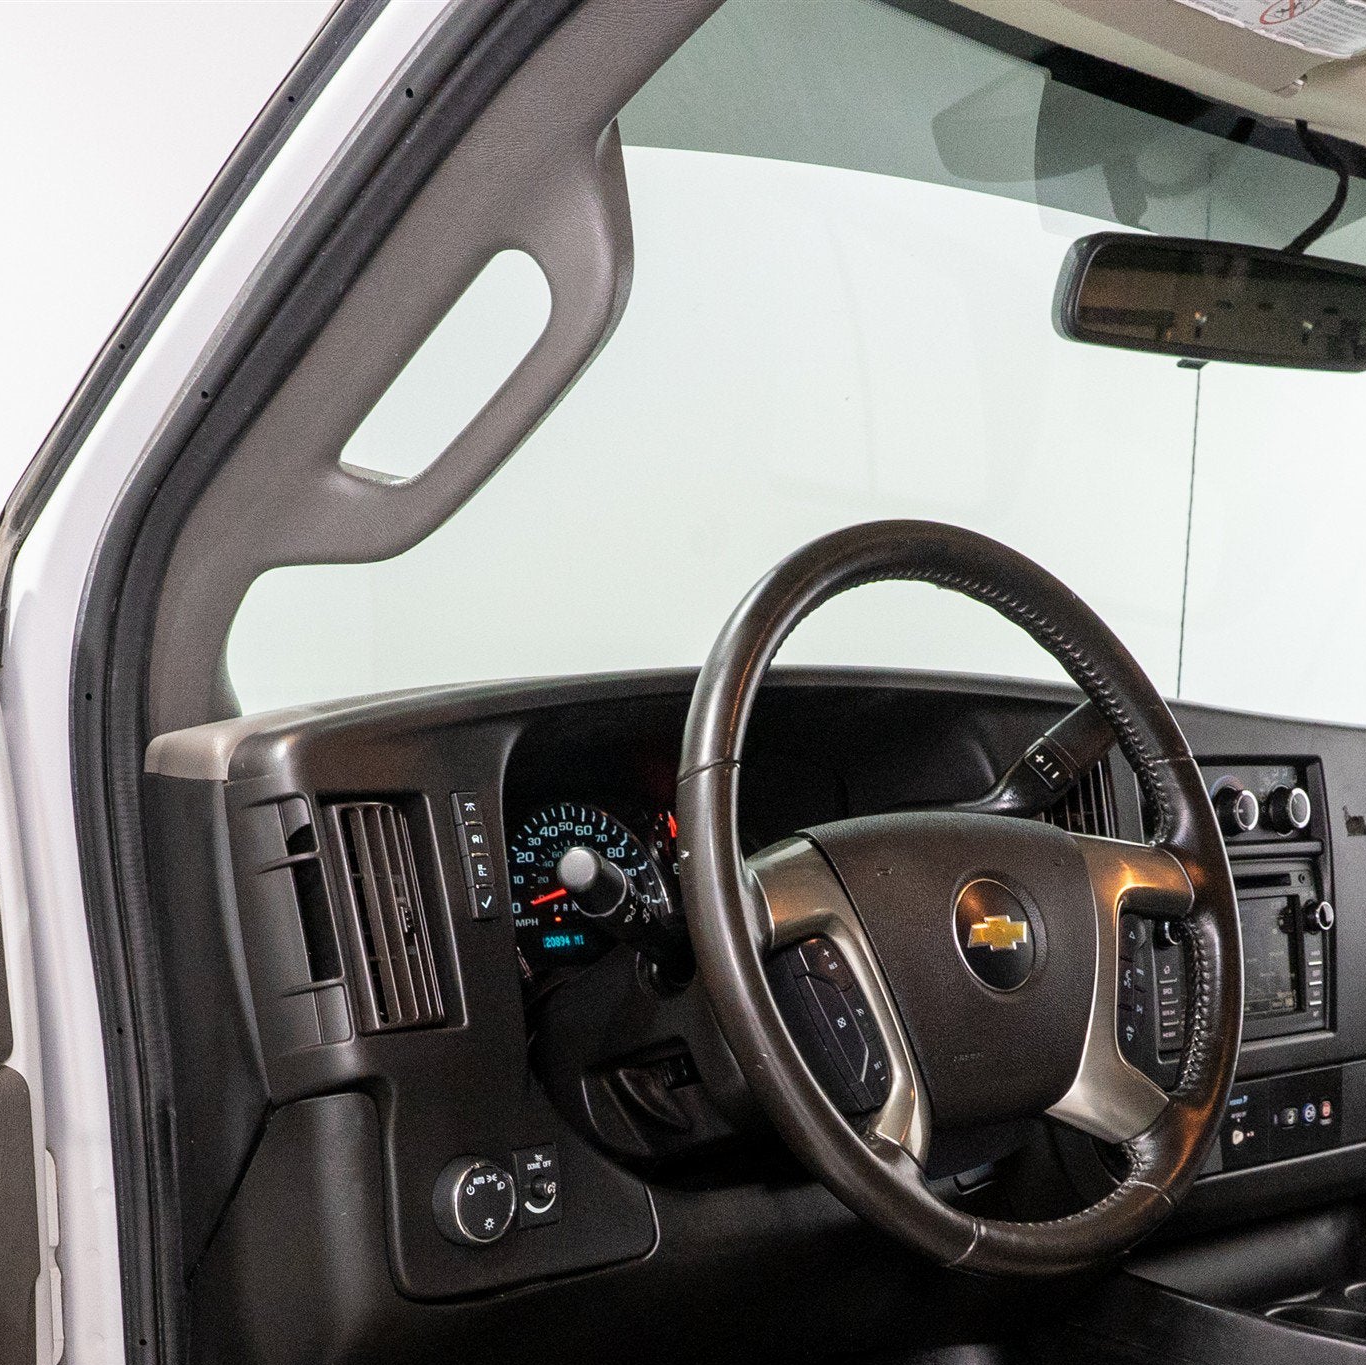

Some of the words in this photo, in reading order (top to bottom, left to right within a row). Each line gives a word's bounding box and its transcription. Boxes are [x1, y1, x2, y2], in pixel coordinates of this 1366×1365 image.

[539, 825, 558, 838] 40
[558, 822, 573, 831] 50
[575, 825, 593, 836] 60
[527, 837, 541, 846] 30
[595, 834, 608, 843] 70
[516, 851, 535, 863] 20
[606, 847, 625, 858] 80
[513, 875, 524, 885] 10
[537, 875, 549, 884] 20
[511, 902, 522, 914] 0
[553, 903, 559, 913] P
[562, 903, 569, 911] R
[515, 918, 539, 927] MPH
[542, 1160, 552, 1168] OFF
